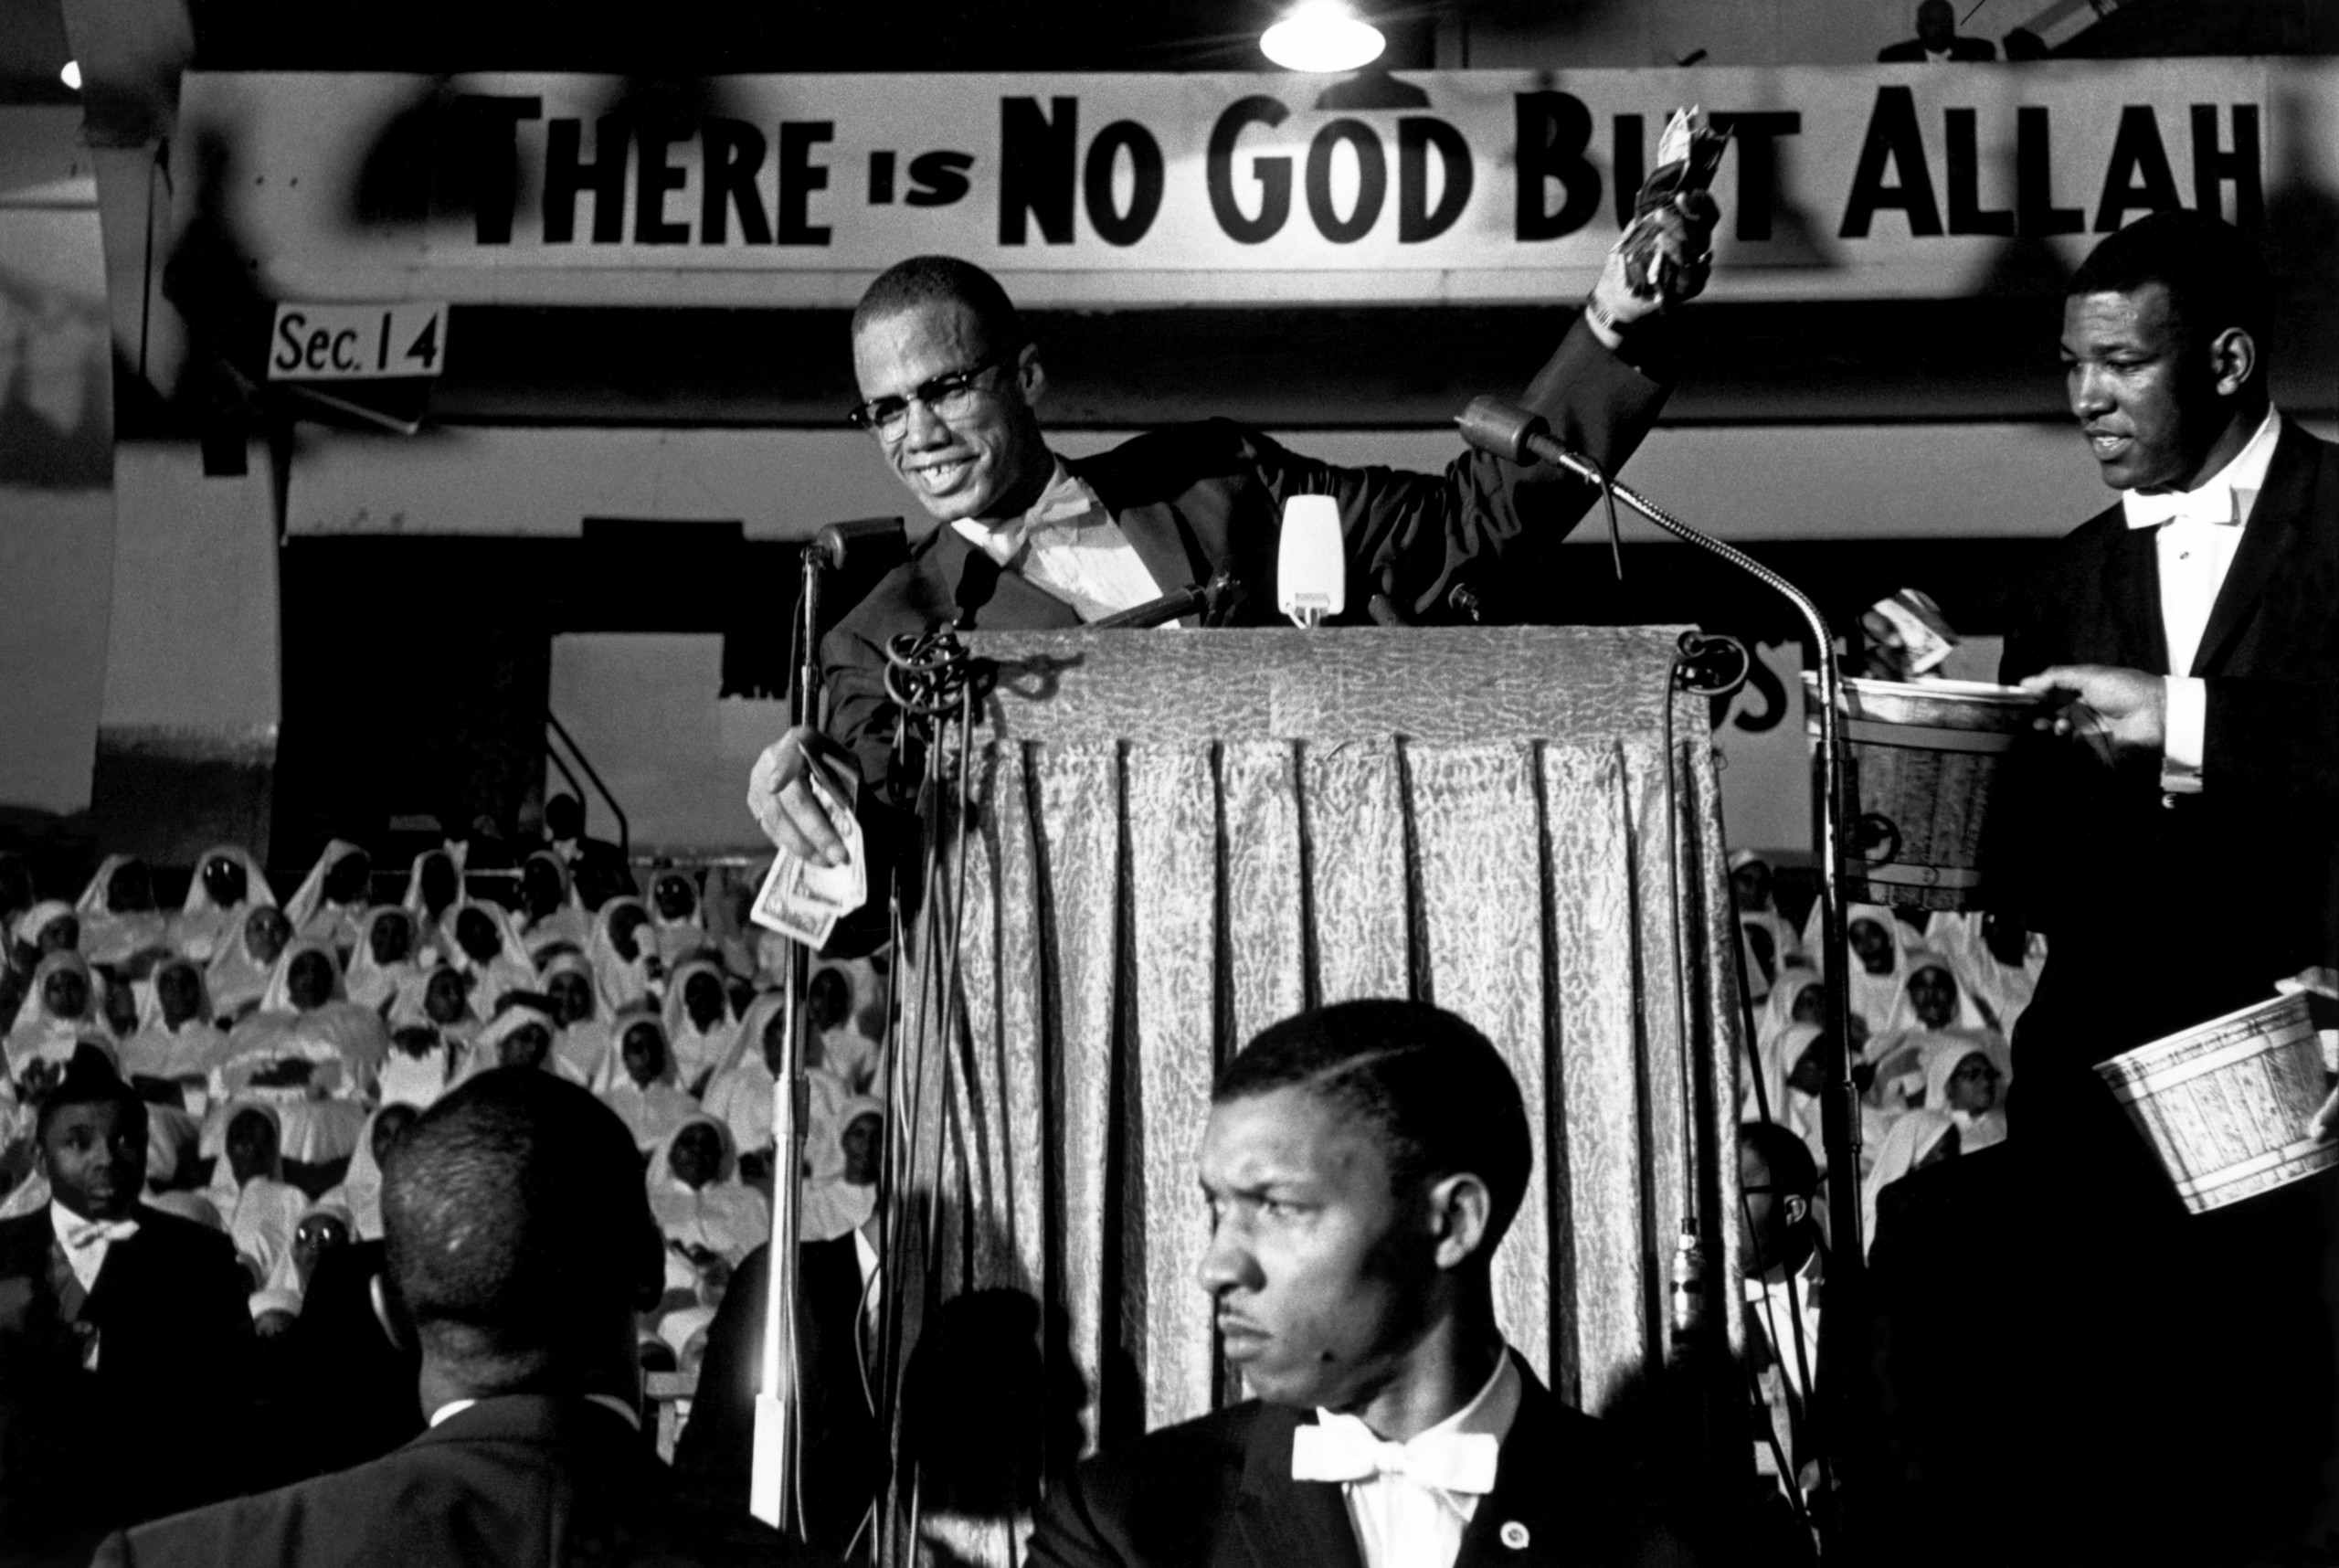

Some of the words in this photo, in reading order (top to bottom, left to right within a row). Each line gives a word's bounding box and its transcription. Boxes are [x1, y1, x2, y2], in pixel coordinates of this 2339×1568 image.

[454, 95, 835, 246] THERE
[868, 149, 976, 207] IS
[998, 96, 1165, 247] NO
[1206, 94, 1474, 245] GOD
[1837, 85, 2266, 238] ALLAH
[275, 312, 363, 372] Sec.
